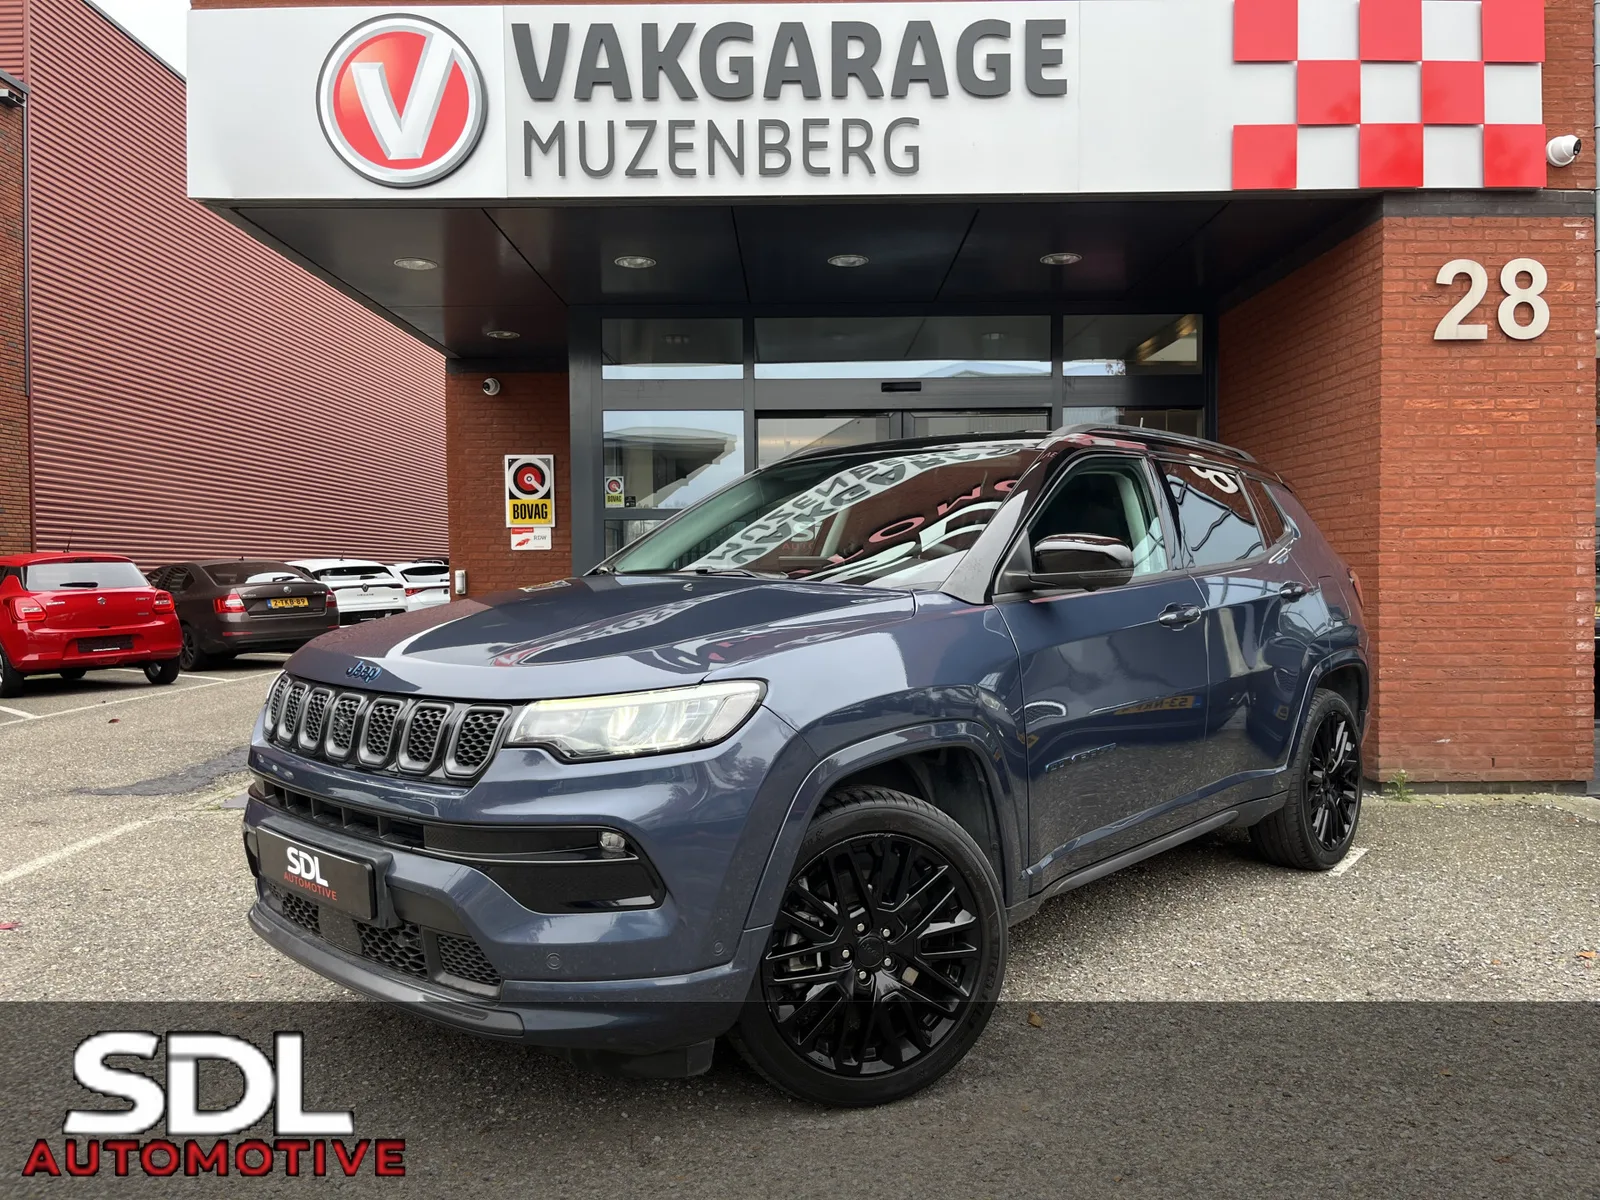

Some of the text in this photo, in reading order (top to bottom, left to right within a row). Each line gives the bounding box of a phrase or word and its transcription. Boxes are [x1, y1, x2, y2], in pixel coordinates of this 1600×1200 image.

[511, 19, 1068, 100] VAKGARAGE
[350, 33, 454, 161] V
[523, 117, 920, 178] MUZENBERG
[1434, 257, 1550, 340] 28
[512, 503, 548, 520] BOVAG
[607, 495, 622, 503] BOVAG
[346, 660, 382, 683] Jeep
[283, 871, 338, 901] AUTOMOTIVE
[286, 846, 329, 887] SDL
